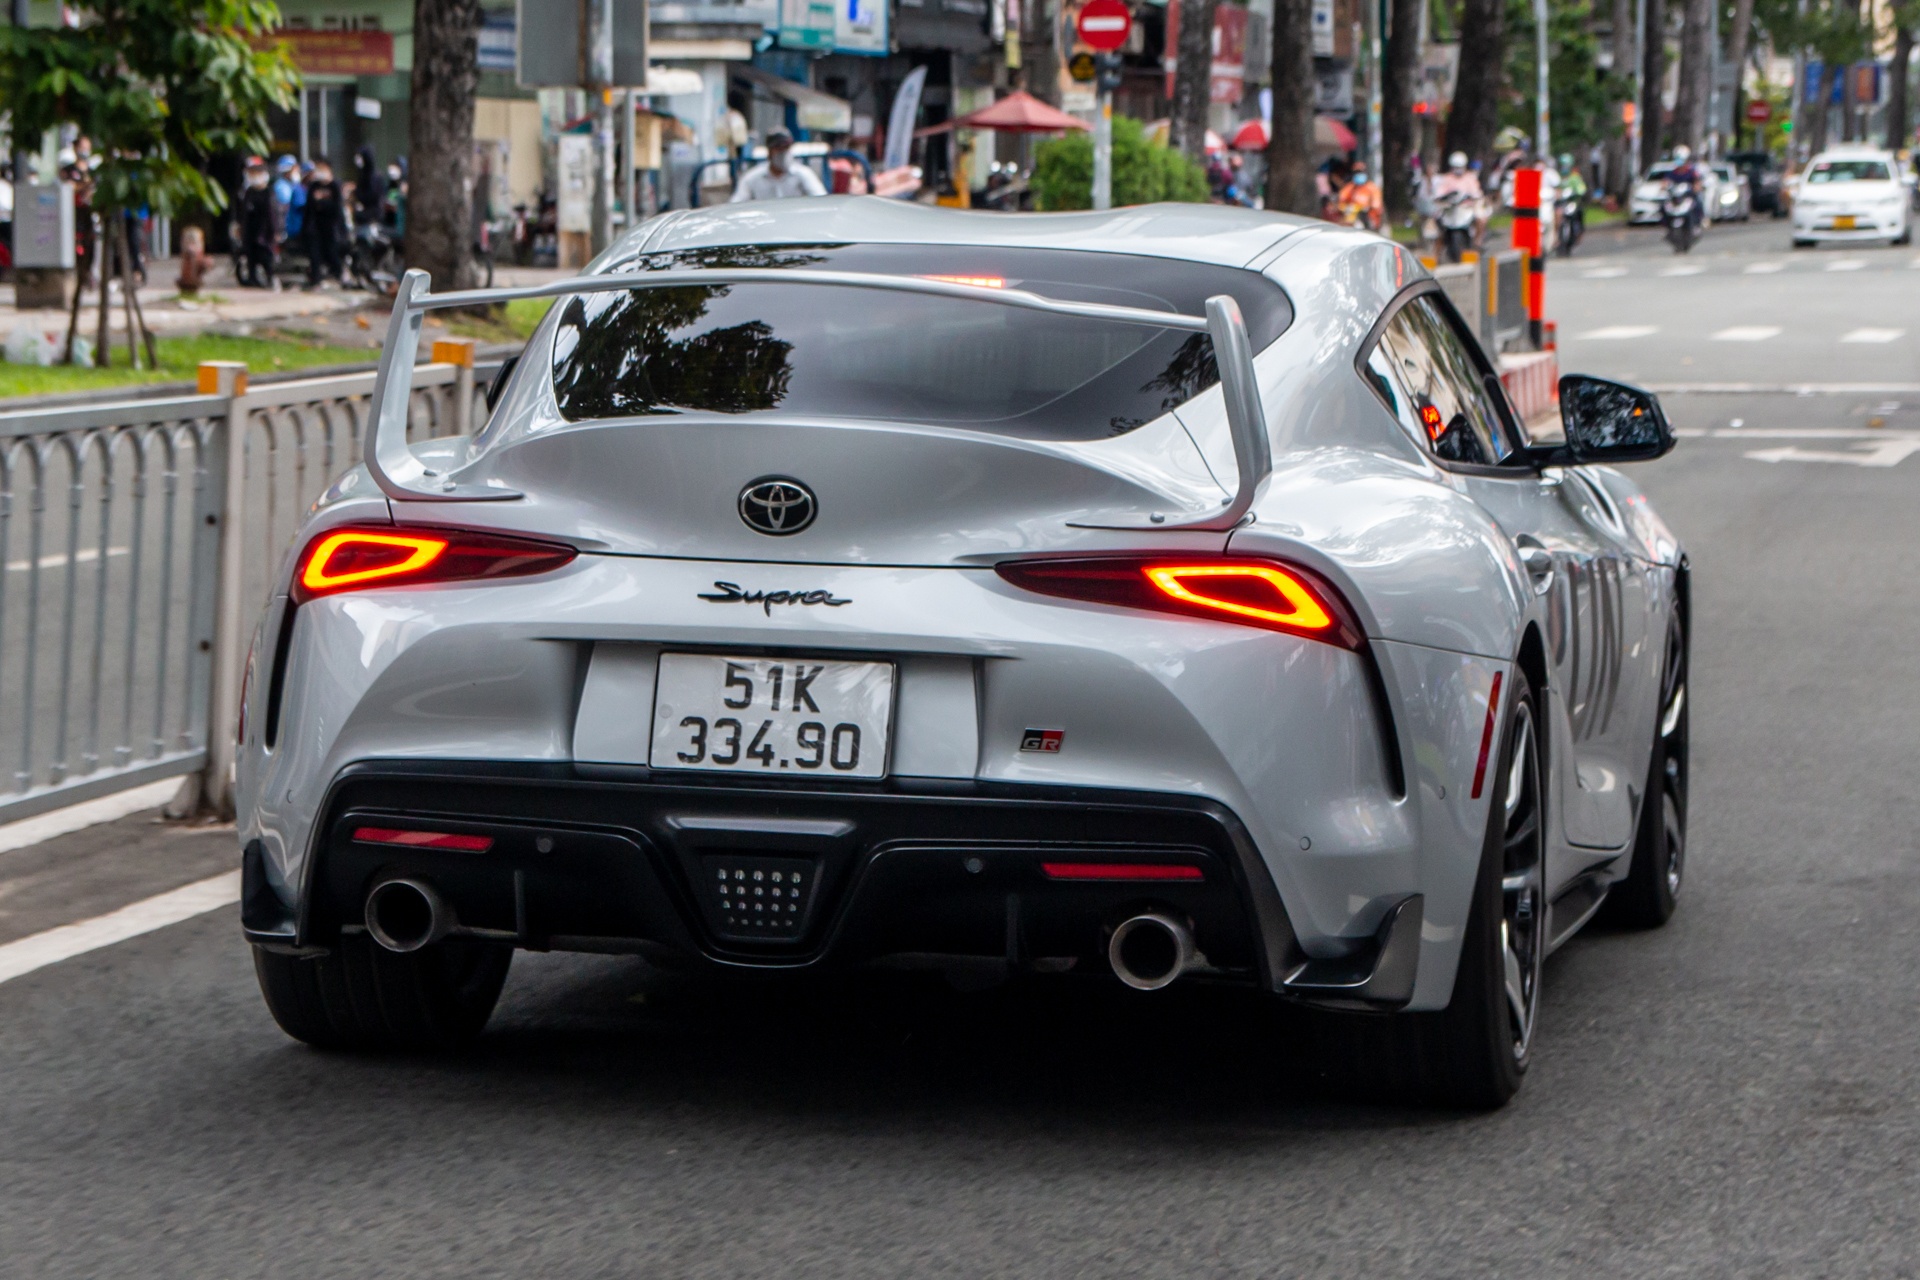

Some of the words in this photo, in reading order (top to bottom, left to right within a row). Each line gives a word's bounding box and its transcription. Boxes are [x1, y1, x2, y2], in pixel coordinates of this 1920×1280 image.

[697, 581, 853, 617] Supra
[724, 662, 825, 713] 51K
[677, 716, 861, 770] 334.90
[1022, 737, 1060, 751] GR
